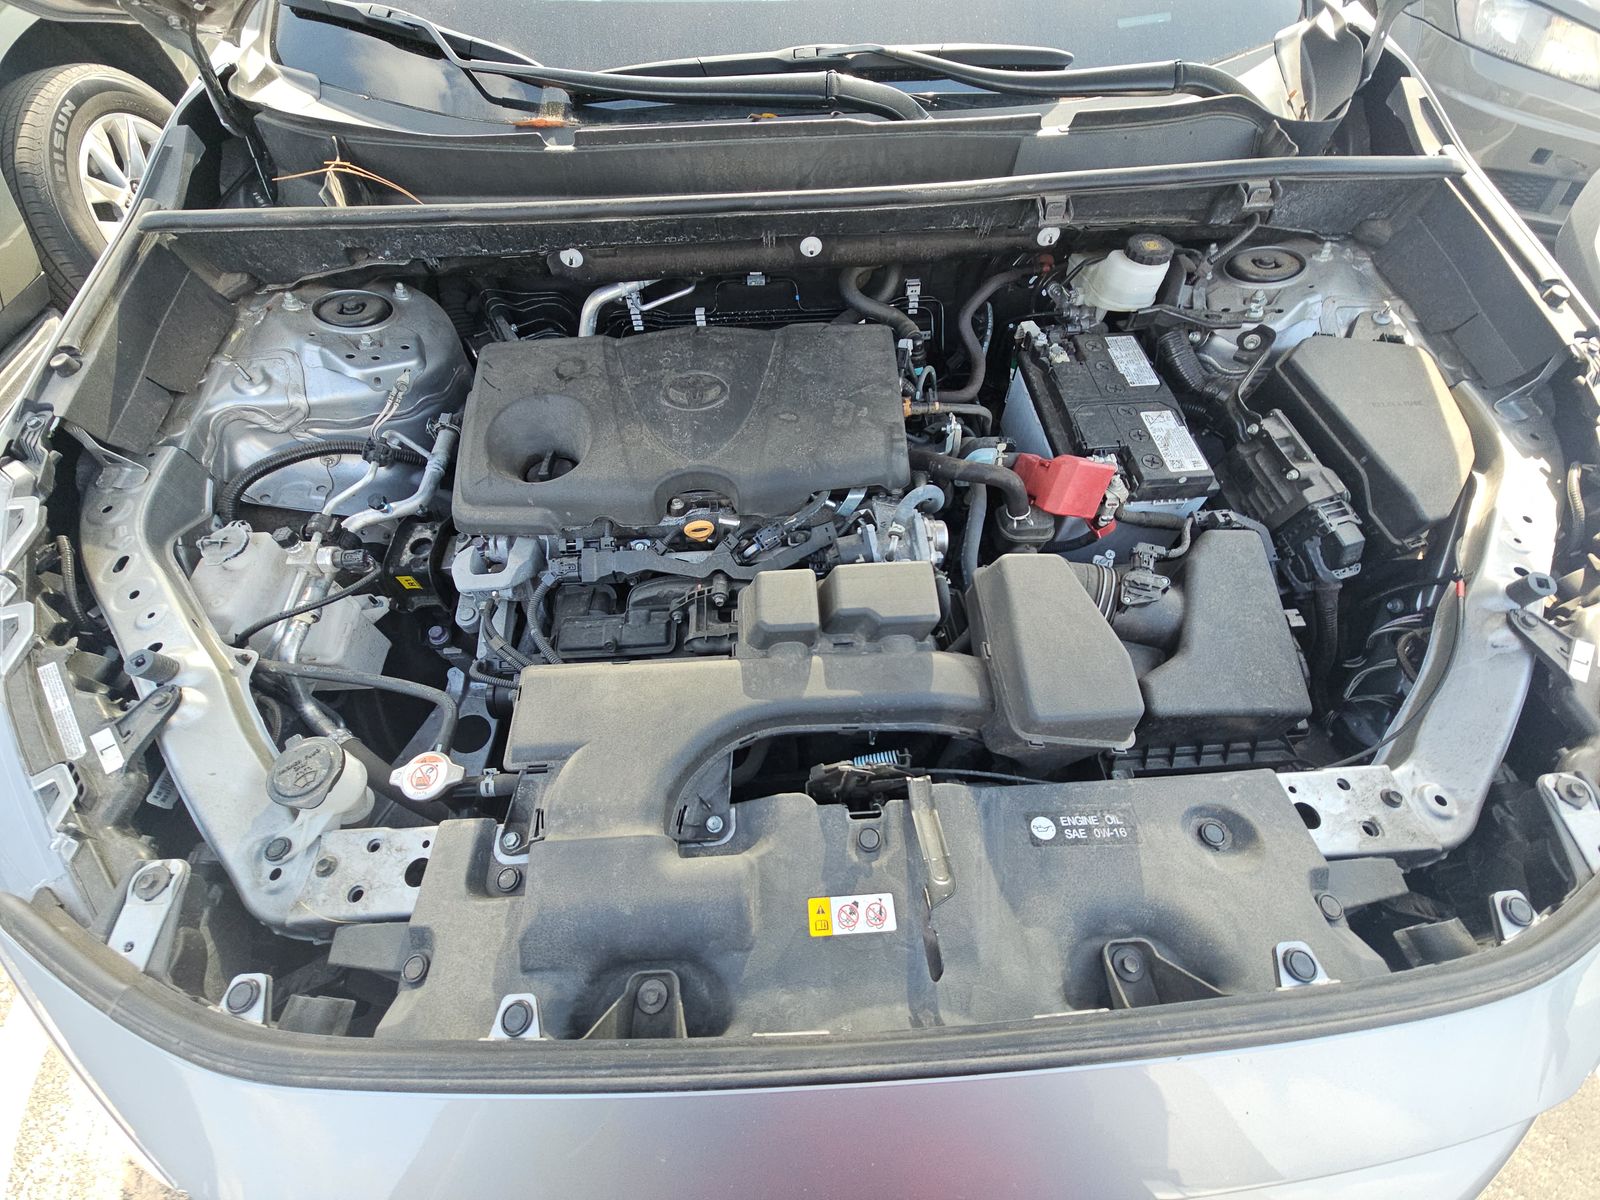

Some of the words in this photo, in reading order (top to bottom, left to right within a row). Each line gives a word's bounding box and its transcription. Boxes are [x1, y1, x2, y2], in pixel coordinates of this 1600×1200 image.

[1059, 815, 1099, 826] ENGINE
[1104, 814, 1124, 825] OIL
[1064, 828, 1088, 839] SAE
[1093, 827, 1128, 838] 0W-16
